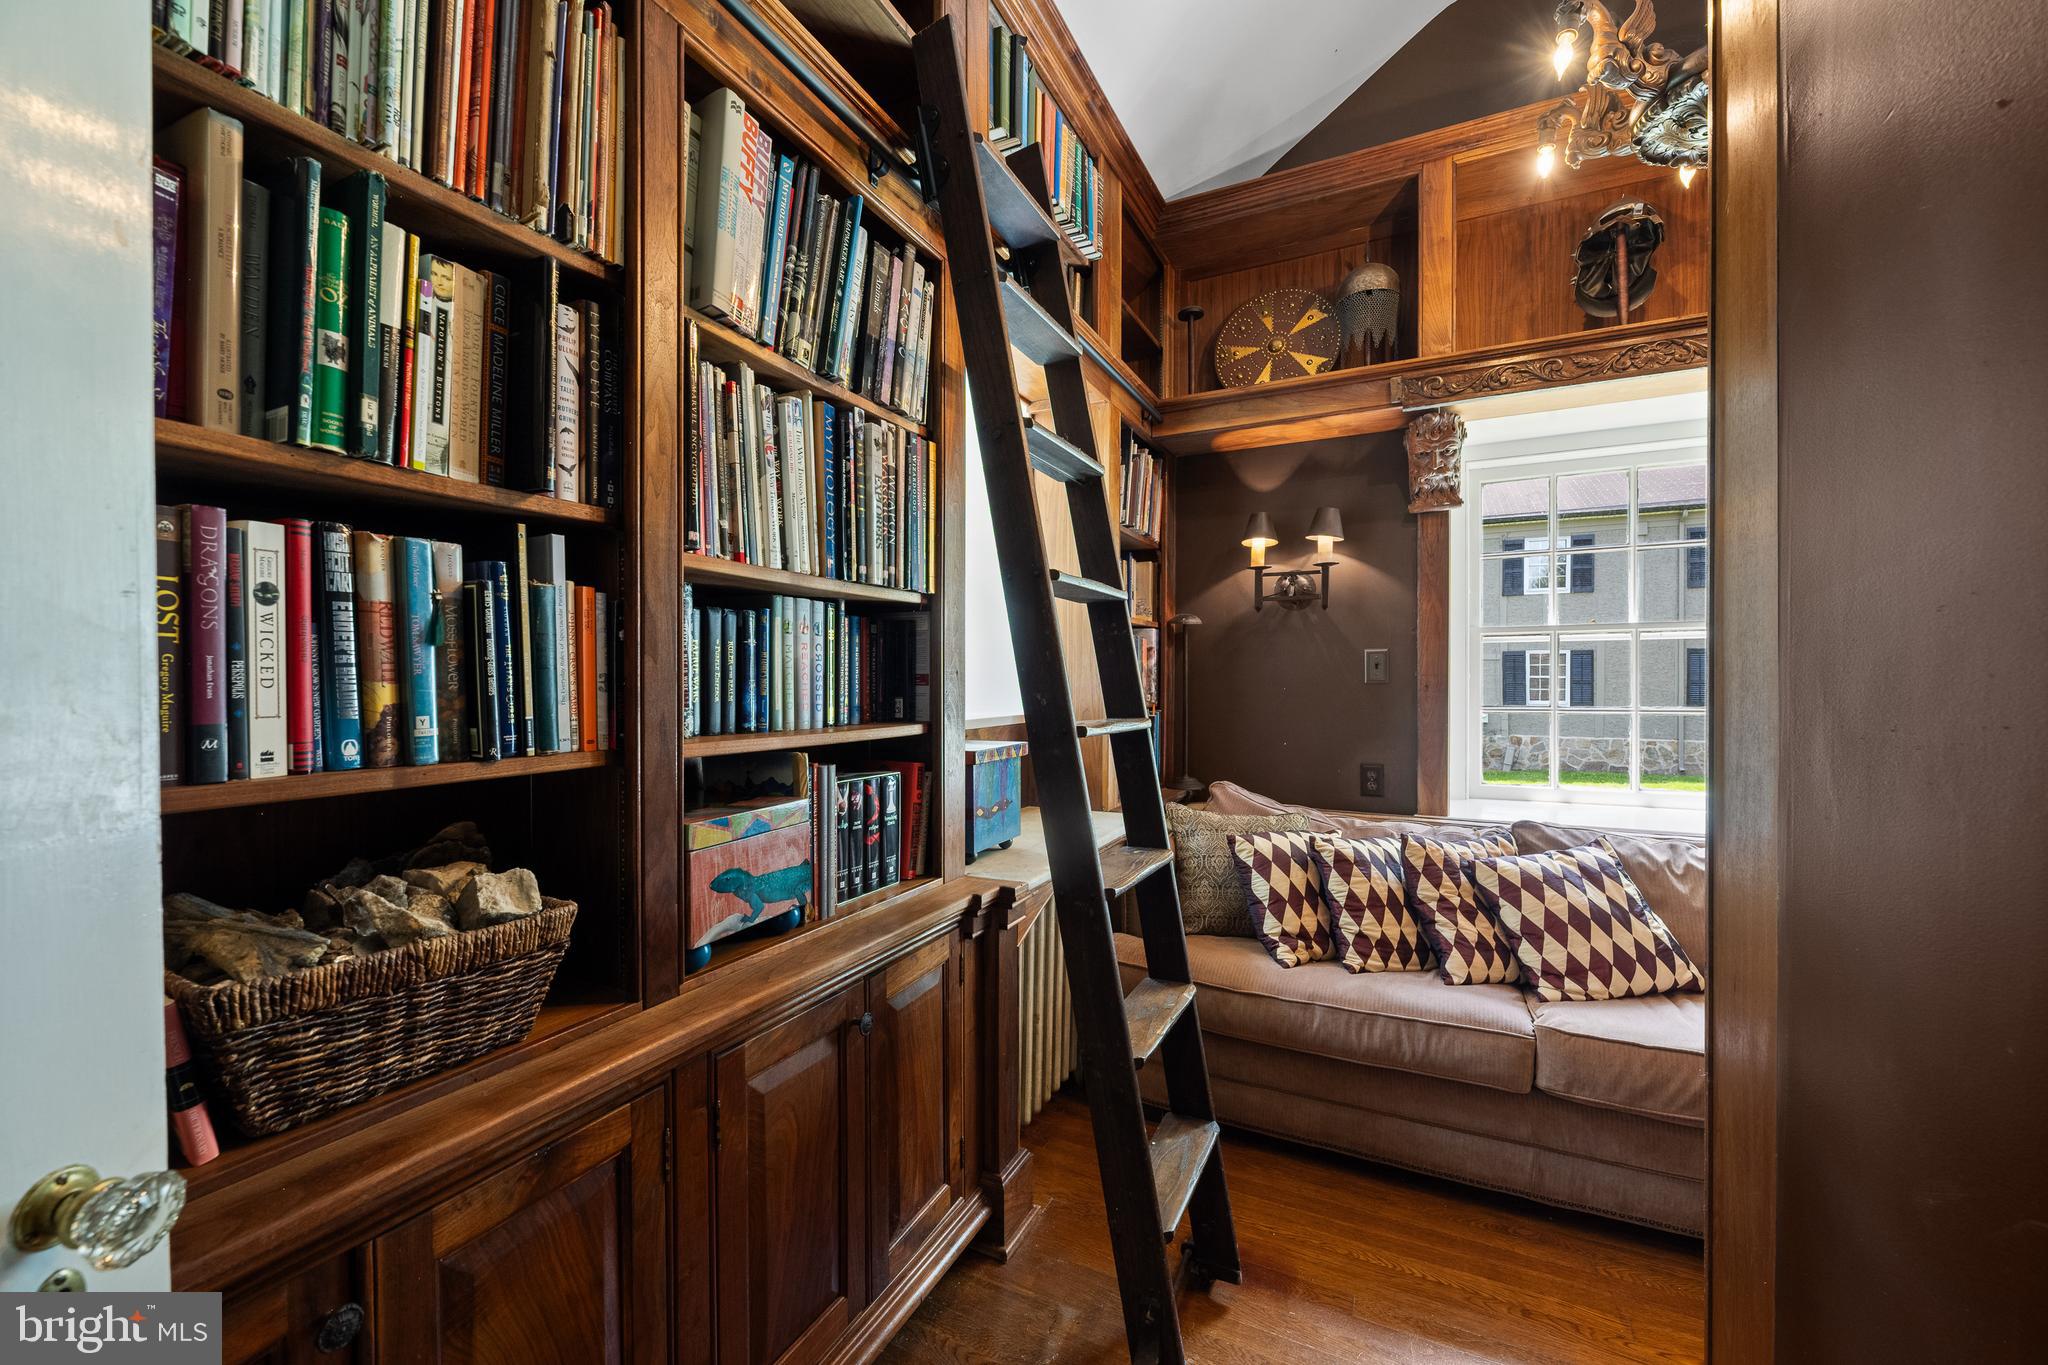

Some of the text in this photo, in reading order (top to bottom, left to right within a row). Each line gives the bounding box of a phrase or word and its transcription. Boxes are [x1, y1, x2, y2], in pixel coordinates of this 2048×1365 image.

[739, 111, 759, 205] BUFFY
[752, 129, 772, 219] BUFFY
[776, 181, 789, 239] MYTHOLOGY
[368, 249, 379, 299] ALPHABET
[494, 283, 506, 327] CIRCE
[873, 274, 884, 314] Animals
[366, 306, 377, 349] ANIMALS
[437, 312, 447, 372] NAPOLEON'S
[590, 311, 600, 341] EYE
[433, 376, 445, 421] BUTTONS
[489, 333, 505, 455] MADELINE MILLER
[590, 378, 600, 409] EYE
[592, 423, 600, 462] LANTING
[690, 384, 700, 506] MARVEL ENCYCLOPEDIA
[774, 460, 782, 480] WAY
[825, 415, 835, 544] MYTHOLOGY
[874, 473, 883, 550] EXPLORERS
[888, 474, 896, 545] WEAPON
[156, 574, 181, 644] LOST
[197, 524, 219, 631] DRAGONS
[205, 655, 215, 700] Jonathan Evans
[260, 611, 275, 690] WICKED
[332, 600, 360, 720] ENDER'S SHADOW
[378, 599, 396, 688] REDWALL
[411, 634, 423, 676] SAWYER
[444, 603, 460, 690] MOSSFLOWER
[785, 644, 793, 710] MATCHED
[800, 642, 809, 711] REACHED
[815, 643, 823, 712] CROSSED
[161, 653, 175, 734] Gregory Maguire
[231, 660, 245, 700] PERSEPOLIS
